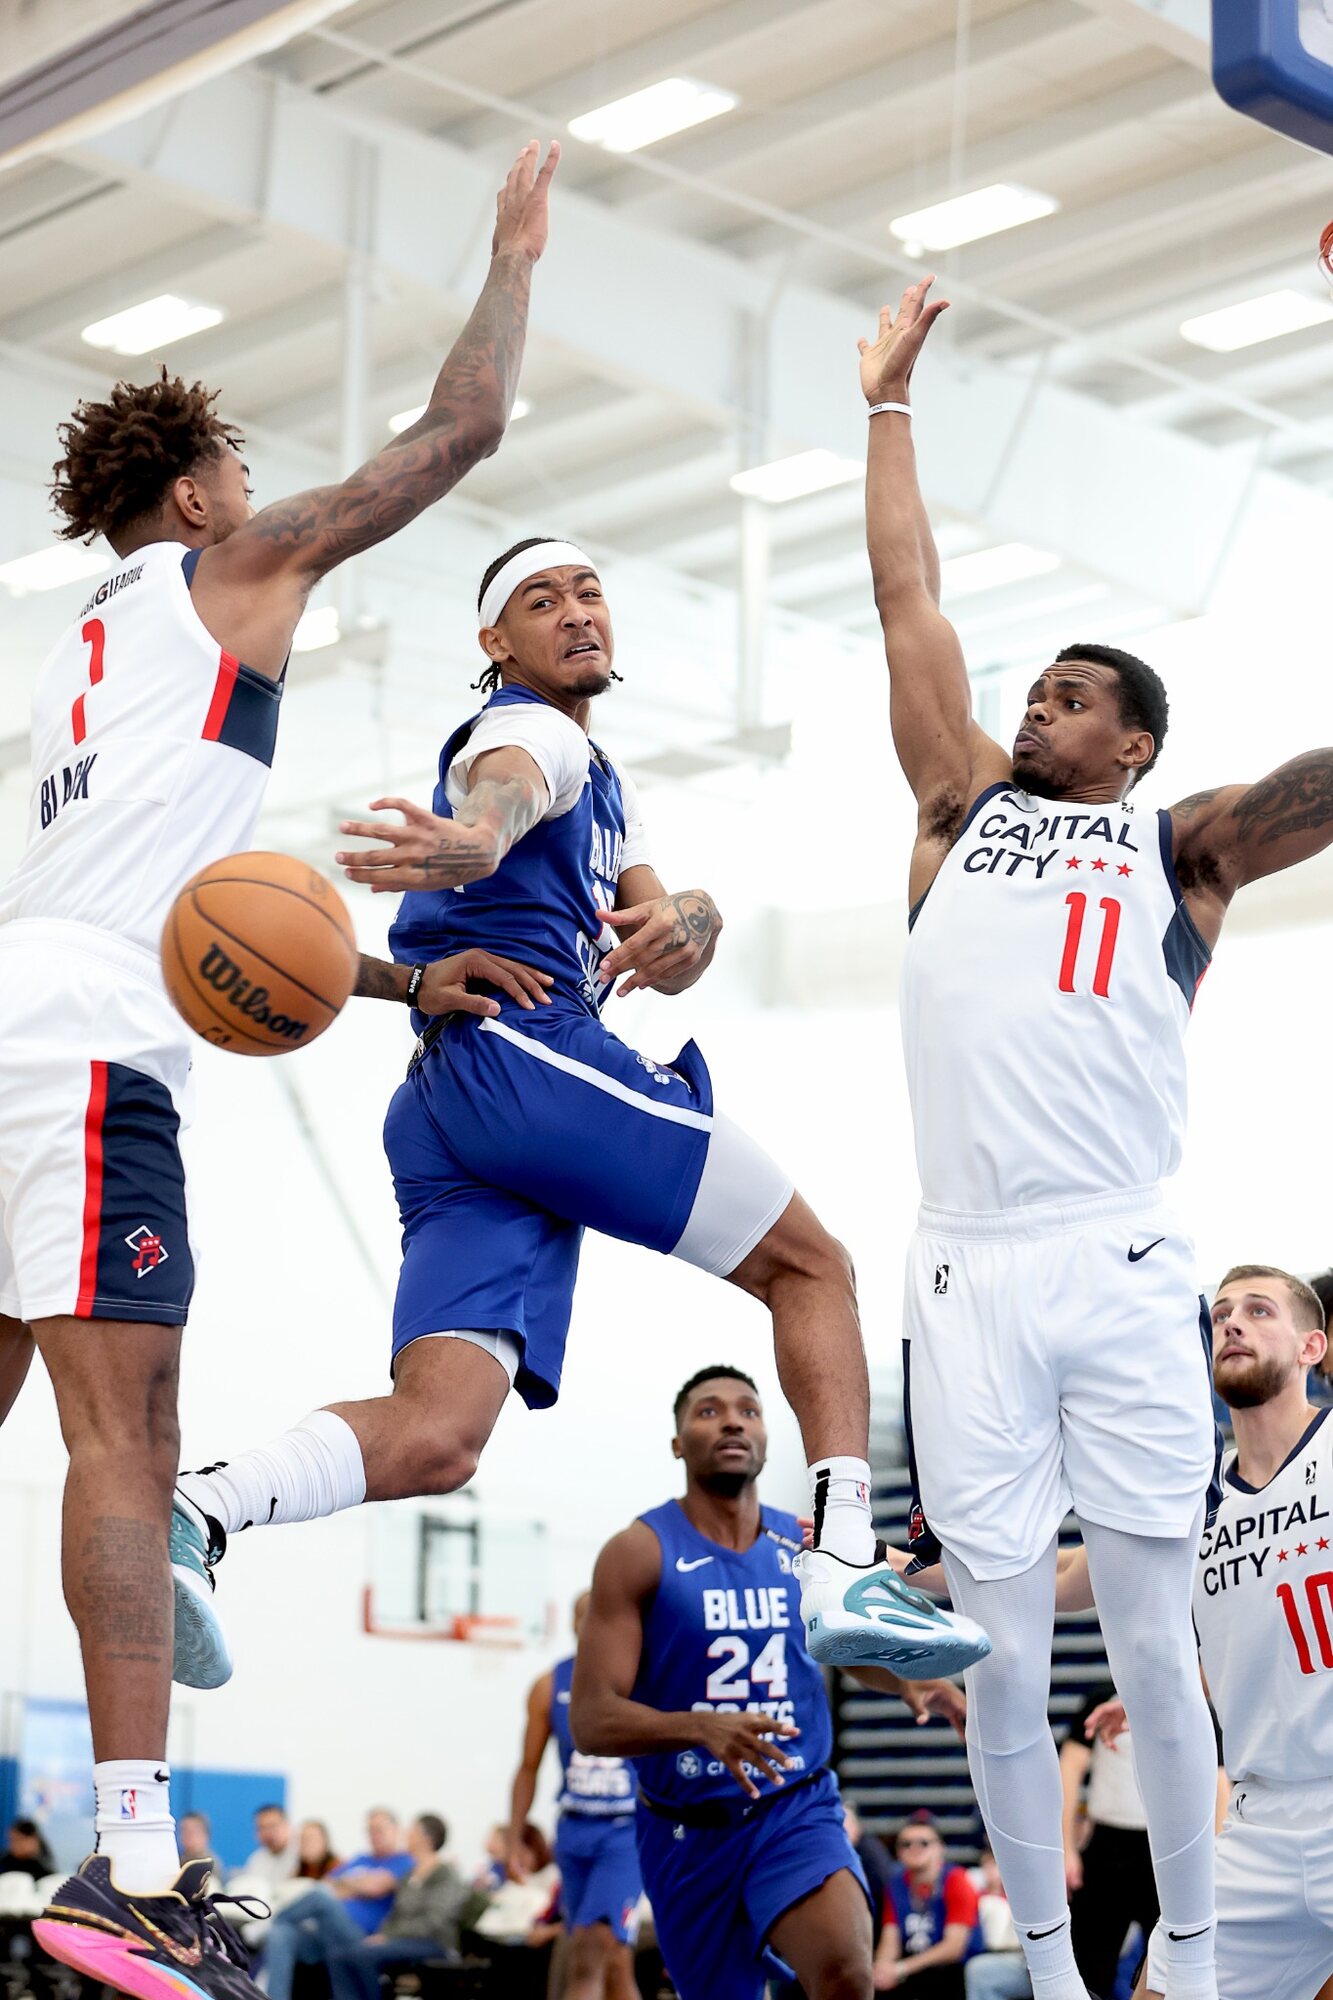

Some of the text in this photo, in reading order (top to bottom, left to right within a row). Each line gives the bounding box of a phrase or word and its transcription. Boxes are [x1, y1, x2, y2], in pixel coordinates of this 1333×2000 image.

[963, 846, 1060, 879] CITY
[979, 814, 1139, 853] CAPITAL
[1058, 891, 1122, 999] 11
[199, 942, 309, 1041] Wilson
[1200, 1494, 1330, 1560] CAPITAL
[1203, 1546, 1271, 1596] CITY
[703, 1587, 791, 1630] BLUE
[706, 1633, 788, 1700] 24
